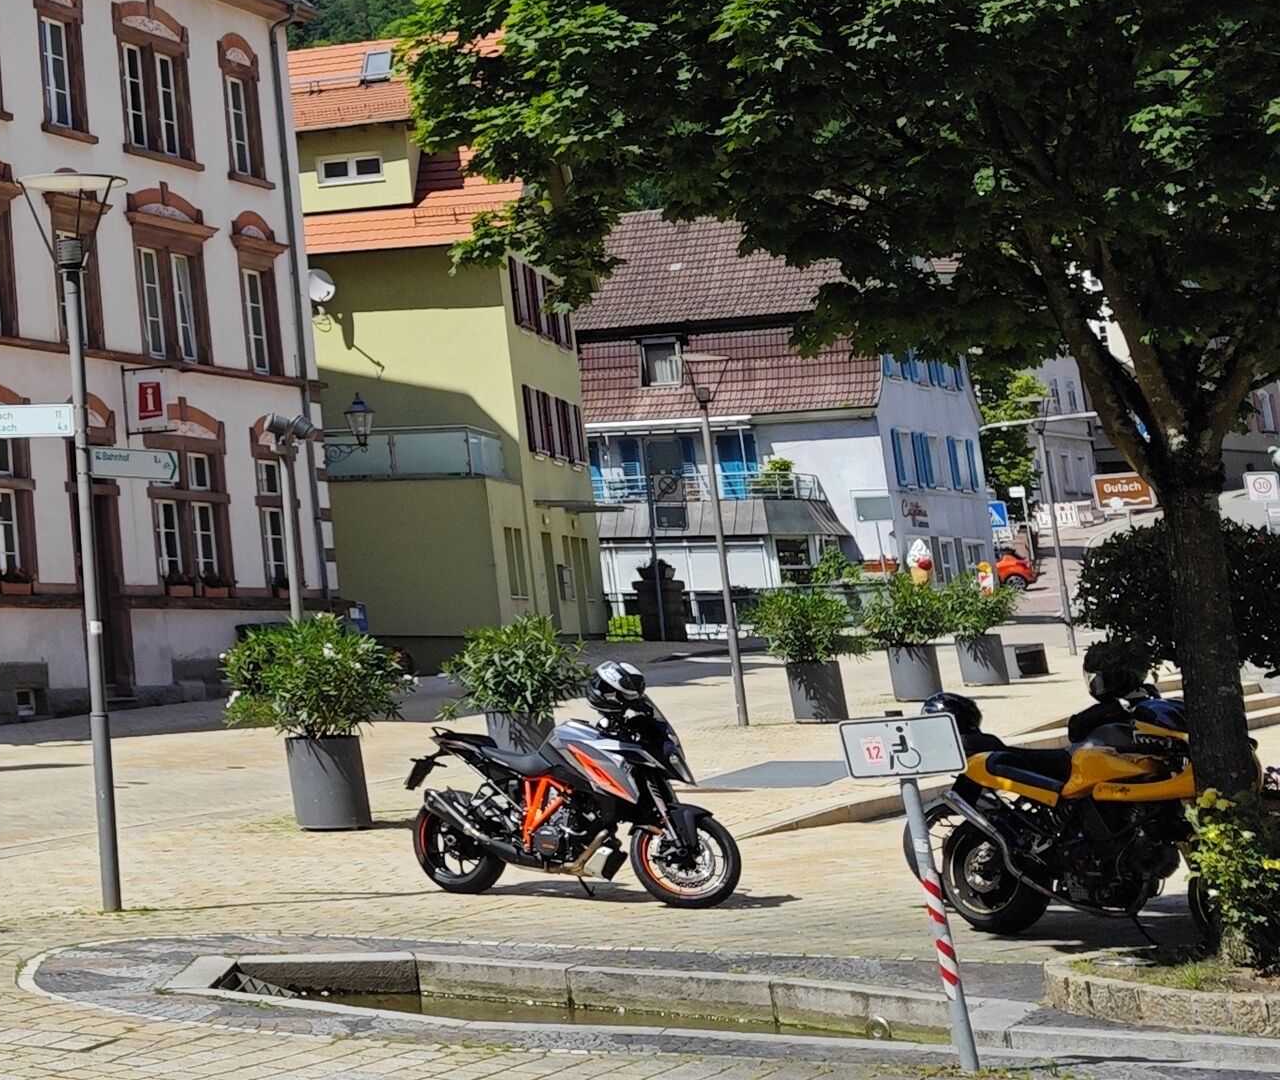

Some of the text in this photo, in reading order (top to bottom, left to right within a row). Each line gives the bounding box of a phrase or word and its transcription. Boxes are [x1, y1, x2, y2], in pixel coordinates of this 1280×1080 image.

[102, 451, 130, 462] Bahnhof
[1103, 481, 1142, 493] Gutach
[1256, 481, 1269, 490] 30
